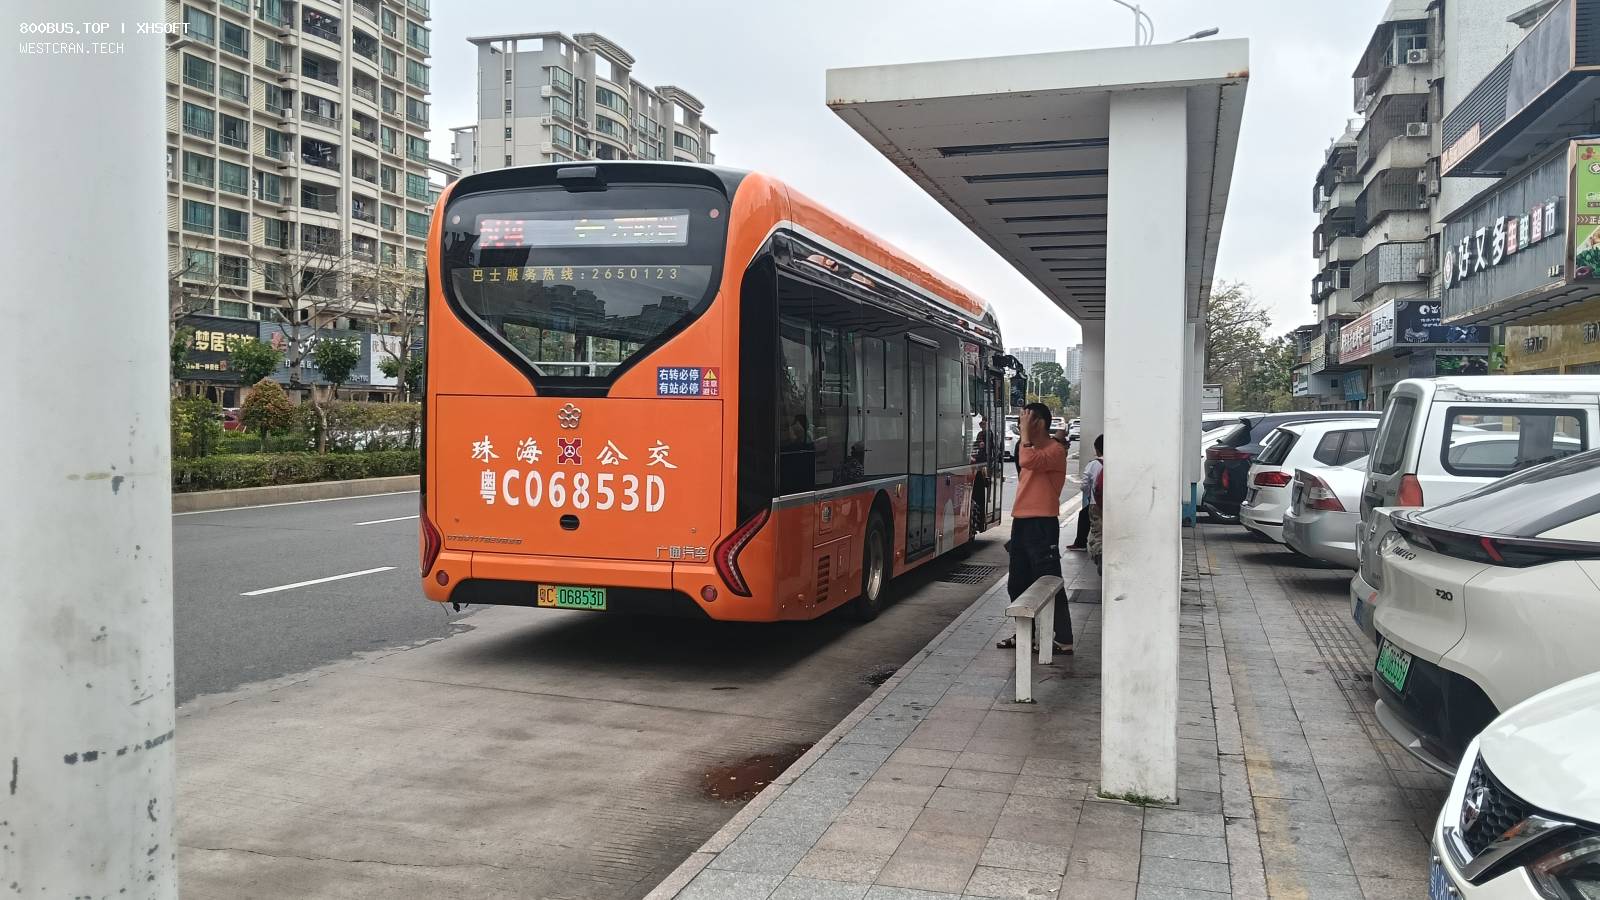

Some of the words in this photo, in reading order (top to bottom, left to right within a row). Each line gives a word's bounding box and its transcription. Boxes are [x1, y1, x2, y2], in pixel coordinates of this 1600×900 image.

[659, 368, 700, 381] 右转必停
[659, 382, 700, 395] 有站必停
[471, 435, 544, 465] 珠海
[596, 439, 679, 469] 公交
[480, 469, 666, 513] 粤C06853D
